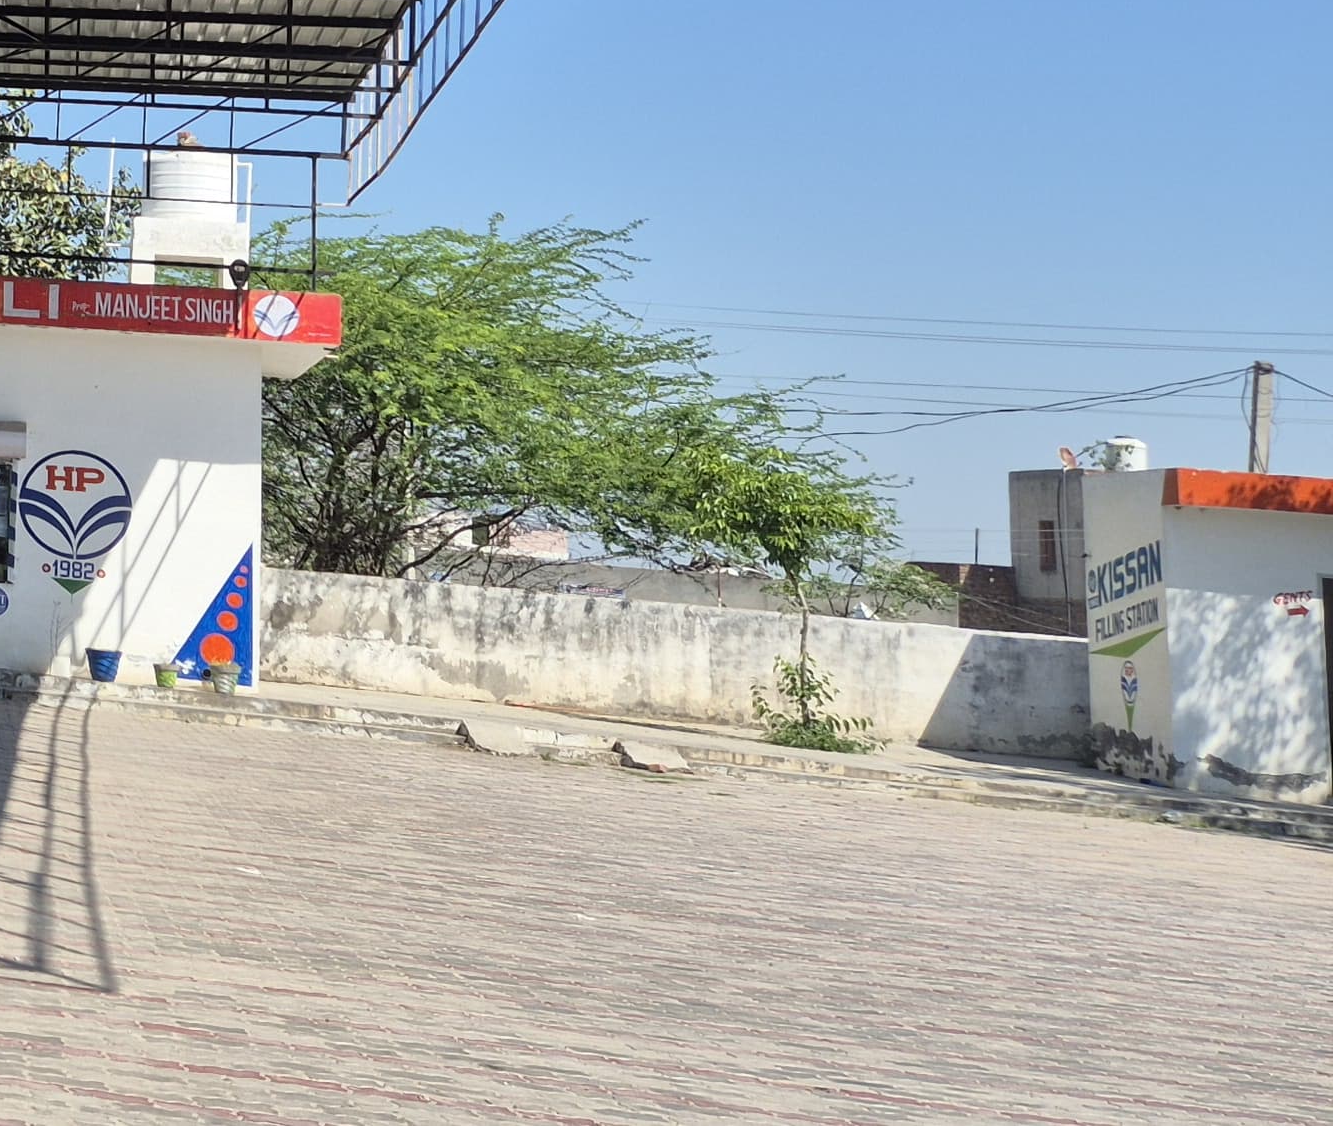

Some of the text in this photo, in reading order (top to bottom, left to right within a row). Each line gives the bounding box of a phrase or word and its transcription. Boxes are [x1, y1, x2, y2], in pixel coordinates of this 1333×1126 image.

[95, 291, 182, 322] MANJEET
[185, 297, 234, 325] SINGH
[45, 465, 105, 492] HP
[52, 559, 95, 580] 1982
[1097, 540, 1163, 607] KISSAN
[1273, 590, 1313, 605] GENTS
[1095, 597, 1159, 643] FILLING STATION
